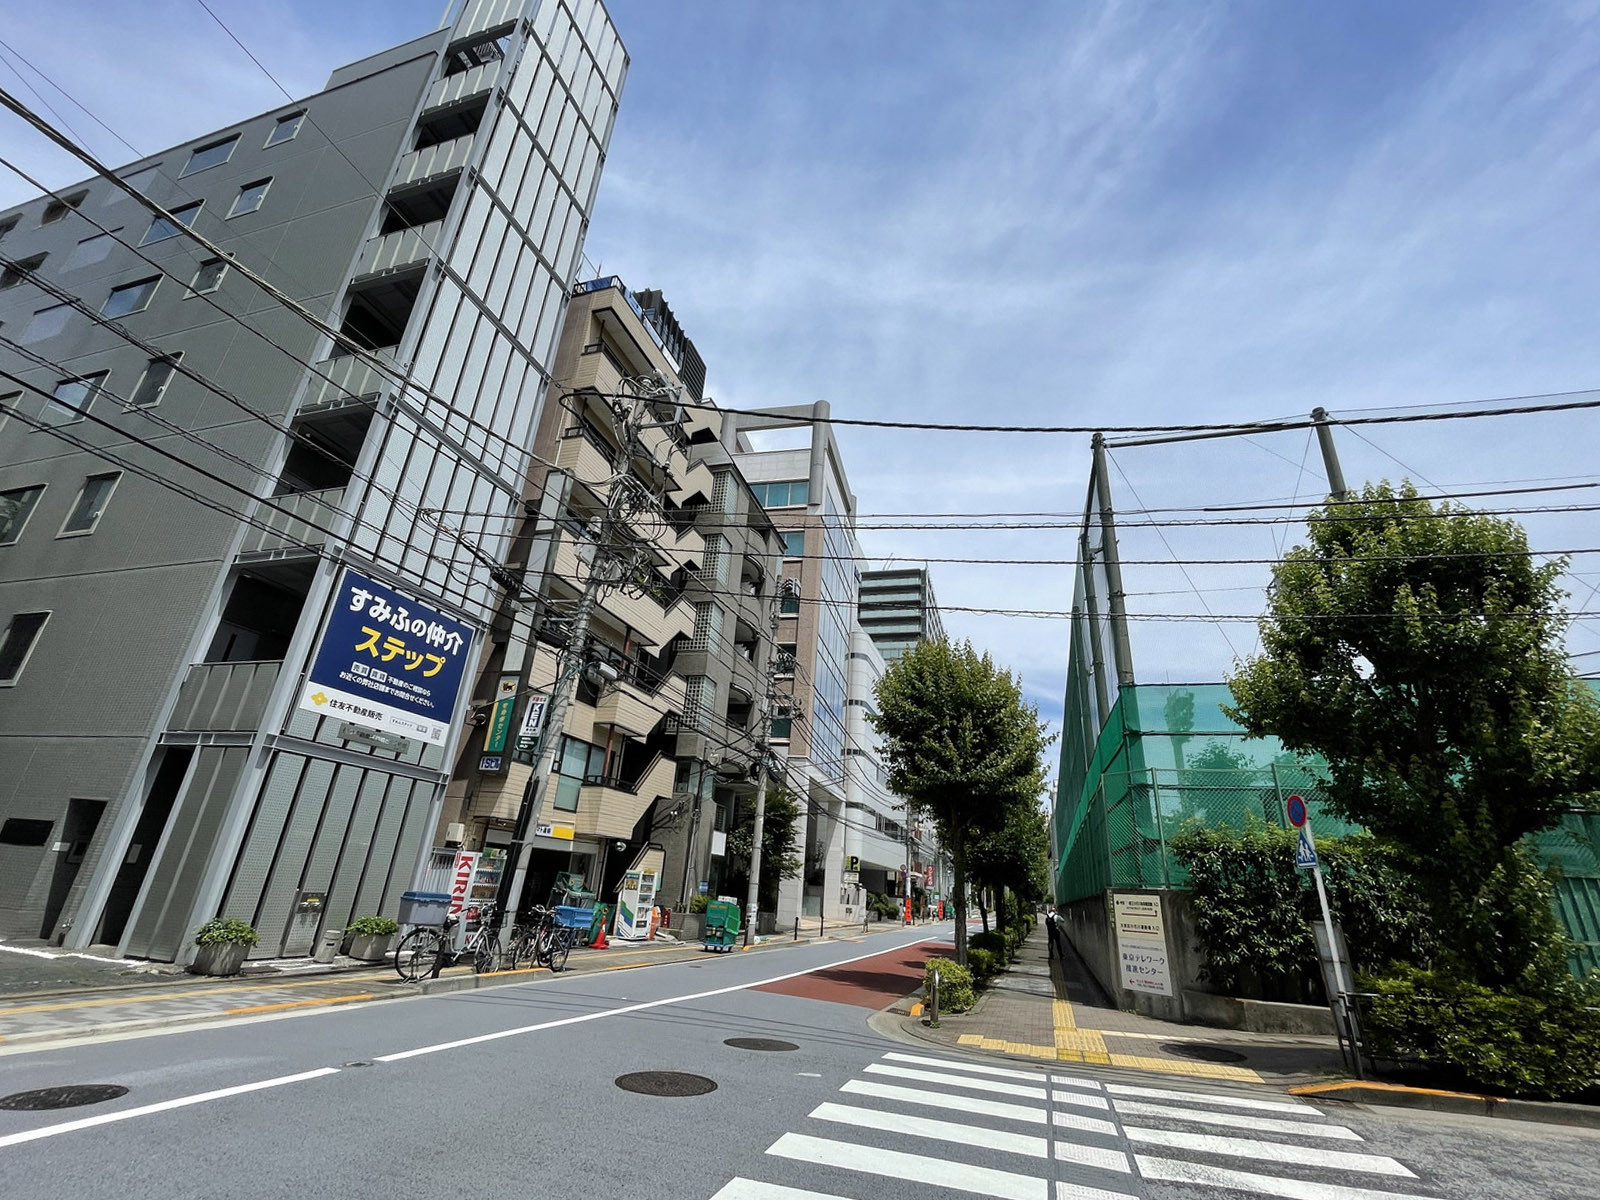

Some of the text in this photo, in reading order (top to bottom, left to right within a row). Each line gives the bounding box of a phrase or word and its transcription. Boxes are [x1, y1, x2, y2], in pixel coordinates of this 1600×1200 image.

[349, 586, 464, 656] すみふの仲介
[355, 626, 446, 677] ステップ
[330, 699, 384, 721] 住友不動産販売
[528, 703, 541, 727] KEN
[850, 856, 859, 870] P
[1122, 952, 1165, 965] 東京テレワーク
